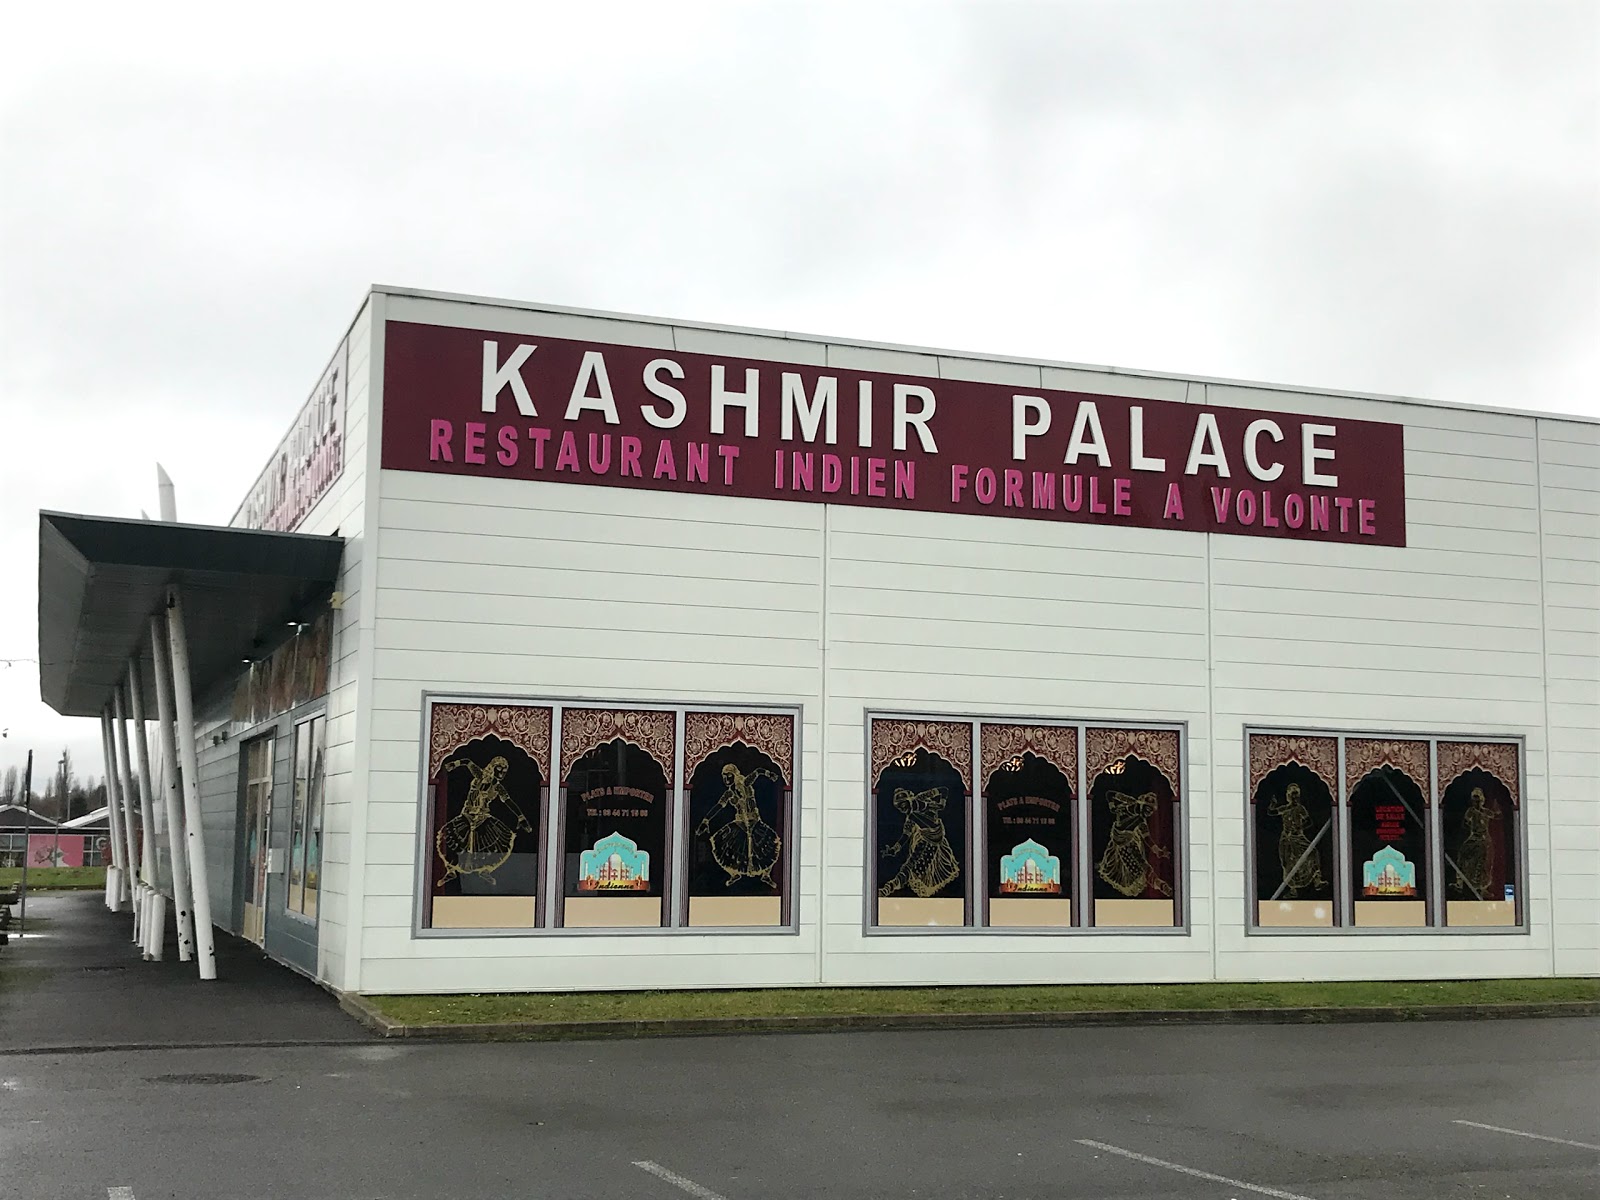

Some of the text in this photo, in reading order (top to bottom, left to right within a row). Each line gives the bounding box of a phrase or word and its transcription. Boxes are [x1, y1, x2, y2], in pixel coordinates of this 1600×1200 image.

[481, 339, 1339, 488] KASHMIR PALACE
[429, 418, 1376, 535] RESTAURANT INDIEN FORMULE A VOLONTE
[594, 881, 635, 890] Indienne
